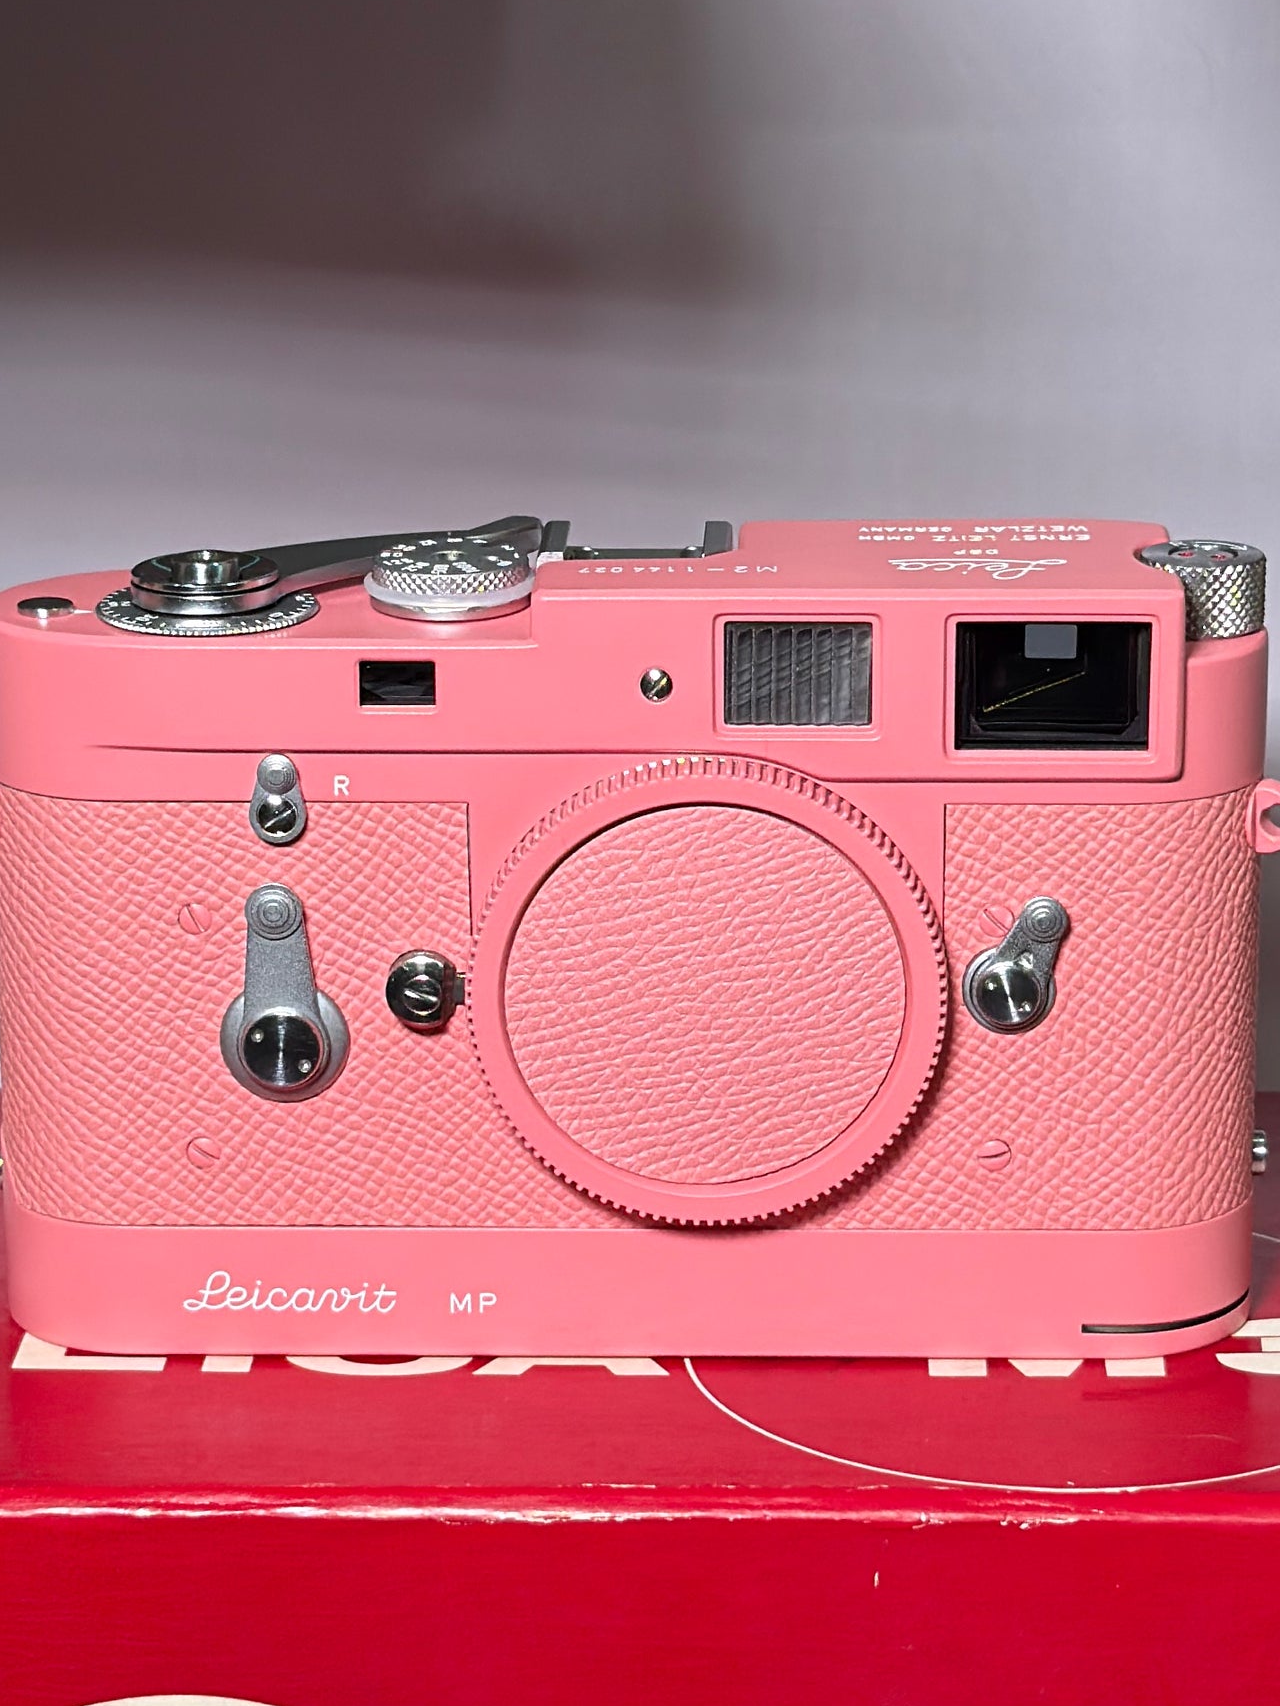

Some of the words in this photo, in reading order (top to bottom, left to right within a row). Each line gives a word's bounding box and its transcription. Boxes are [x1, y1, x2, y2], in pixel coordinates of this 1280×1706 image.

[888, 557, 1067, 580] Leica
[333, 776, 350, 796] R
[182, 1269, 397, 1314] Leicavit
[449, 1291, 498, 1314] MP
